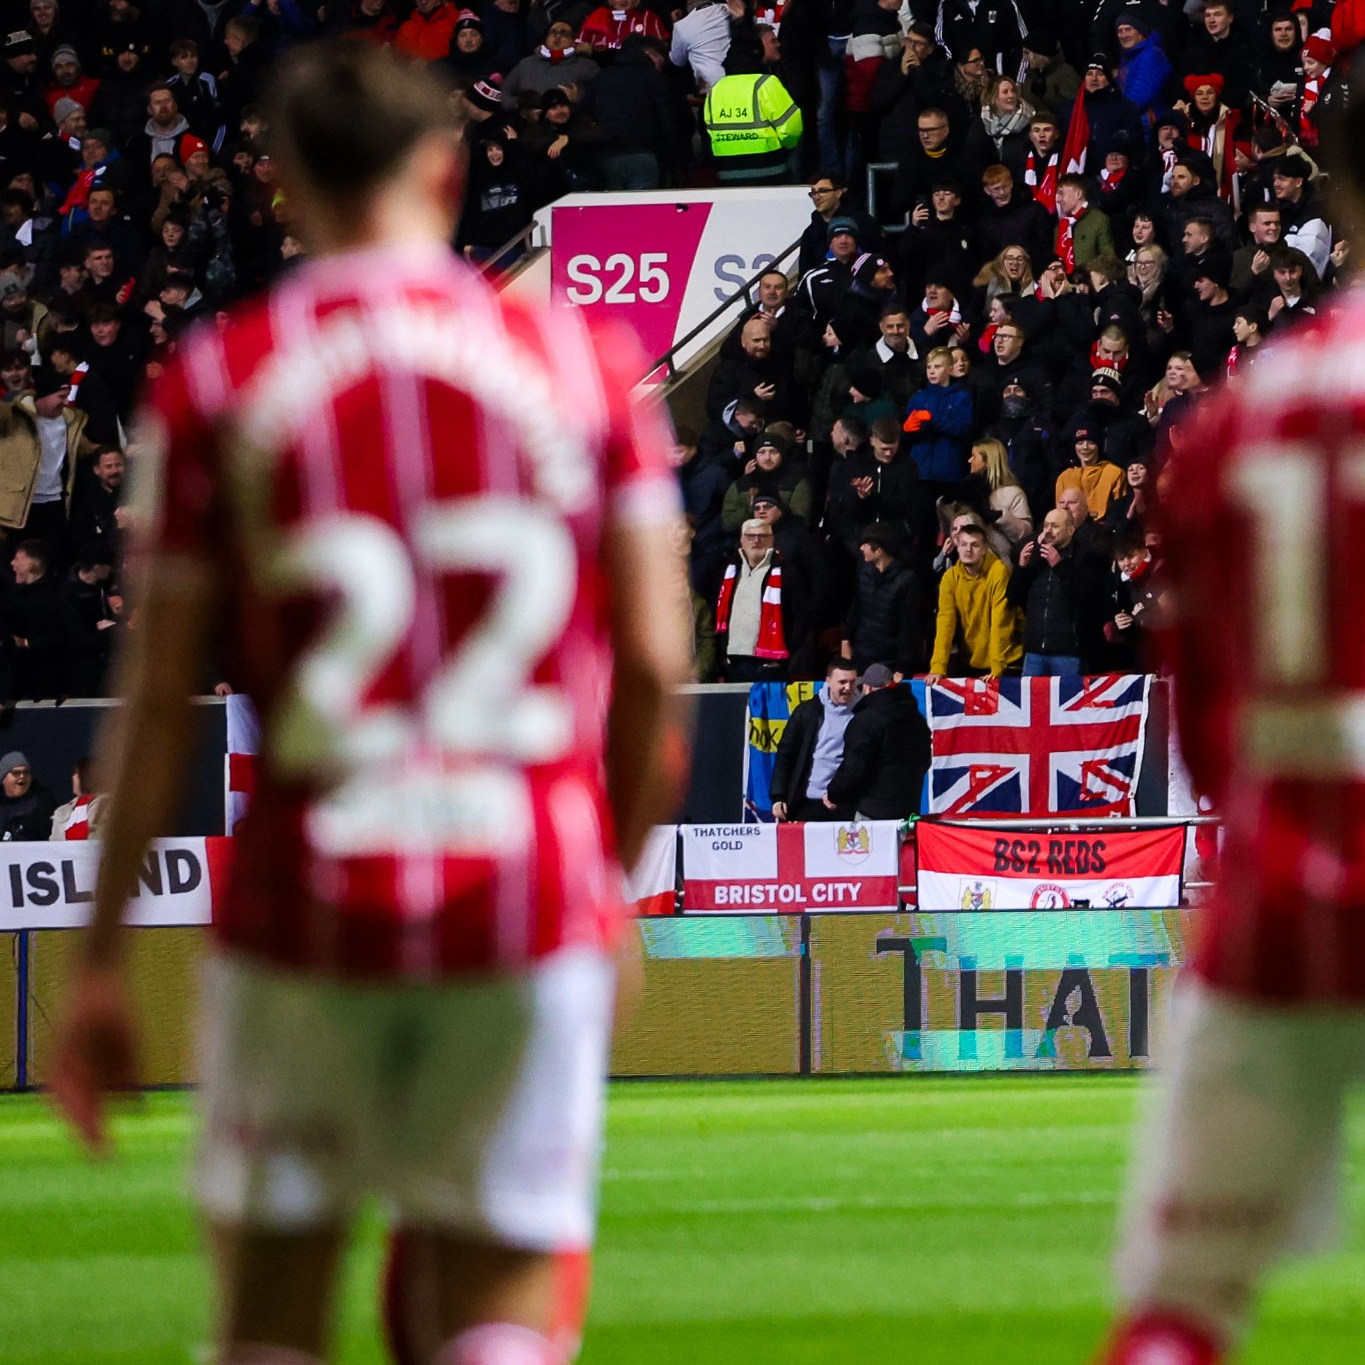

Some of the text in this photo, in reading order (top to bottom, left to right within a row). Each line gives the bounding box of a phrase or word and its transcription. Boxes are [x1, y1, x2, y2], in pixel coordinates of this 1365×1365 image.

[719, 107, 748, 119] AJ 34
[715, 131, 759, 143] STEWARD
[565, 252, 671, 305] S25
[287, 500, 580, 765] 22
[693, 826, 762, 838] THATCHERS
[712, 841, 744, 852] GOLD
[993, 837, 1107, 875] BS2 REDS
[8, 848, 202, 908] ISLND
[714, 882, 863, 905] BRISTOL CITY
